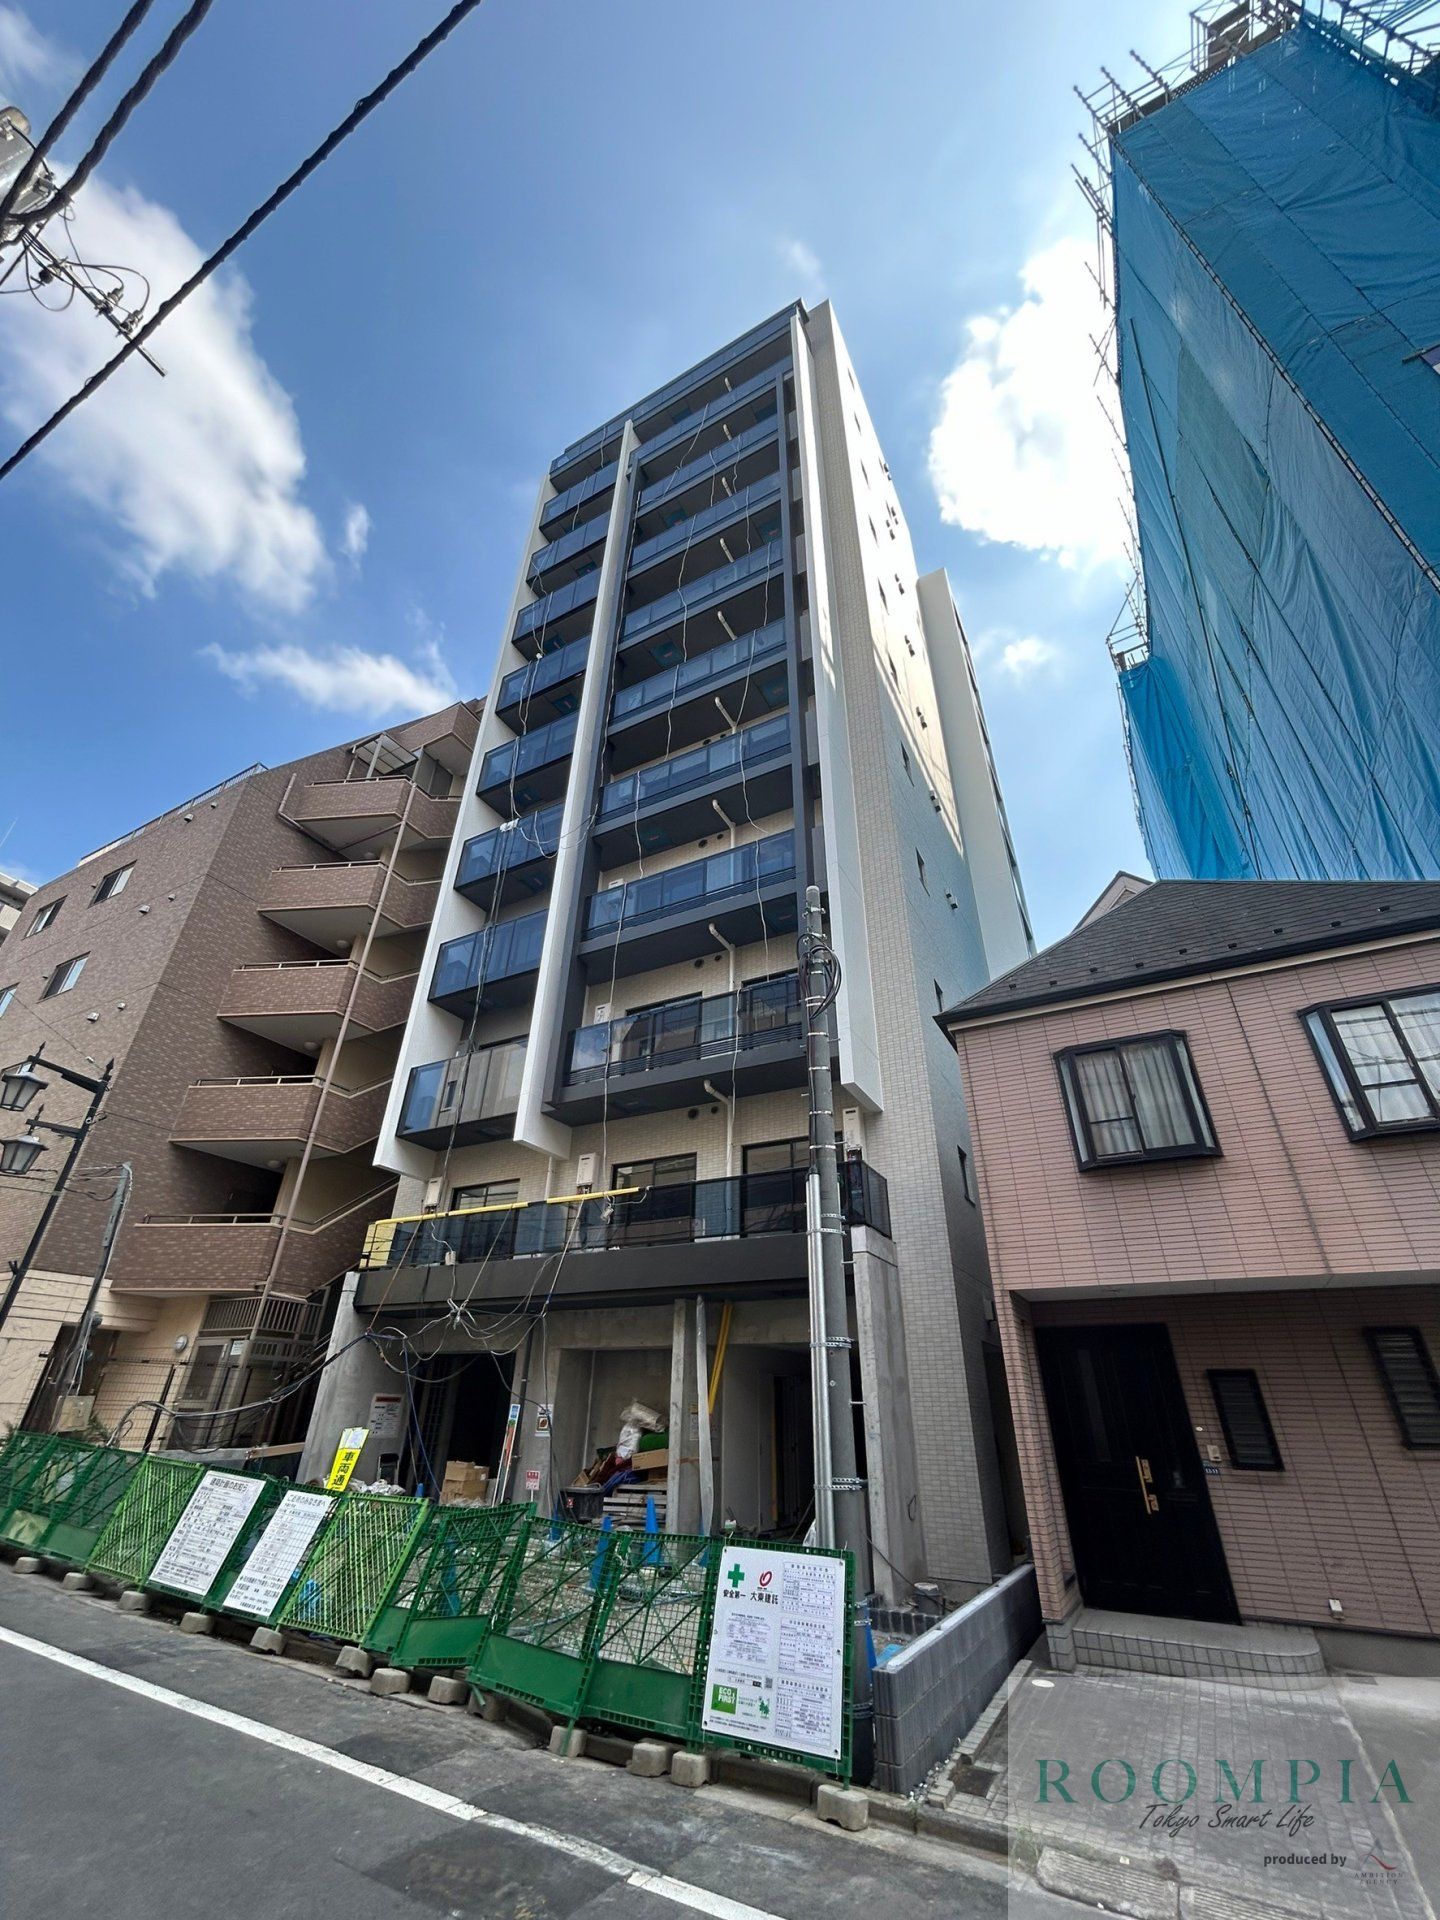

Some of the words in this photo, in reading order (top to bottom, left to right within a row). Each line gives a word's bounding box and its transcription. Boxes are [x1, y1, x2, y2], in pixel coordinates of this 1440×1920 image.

[331, 1451, 356, 1489] 車両通
[723, 1589, 746, 1599] 安全第一
[750, 1591, 779, 1604] 大東建託
